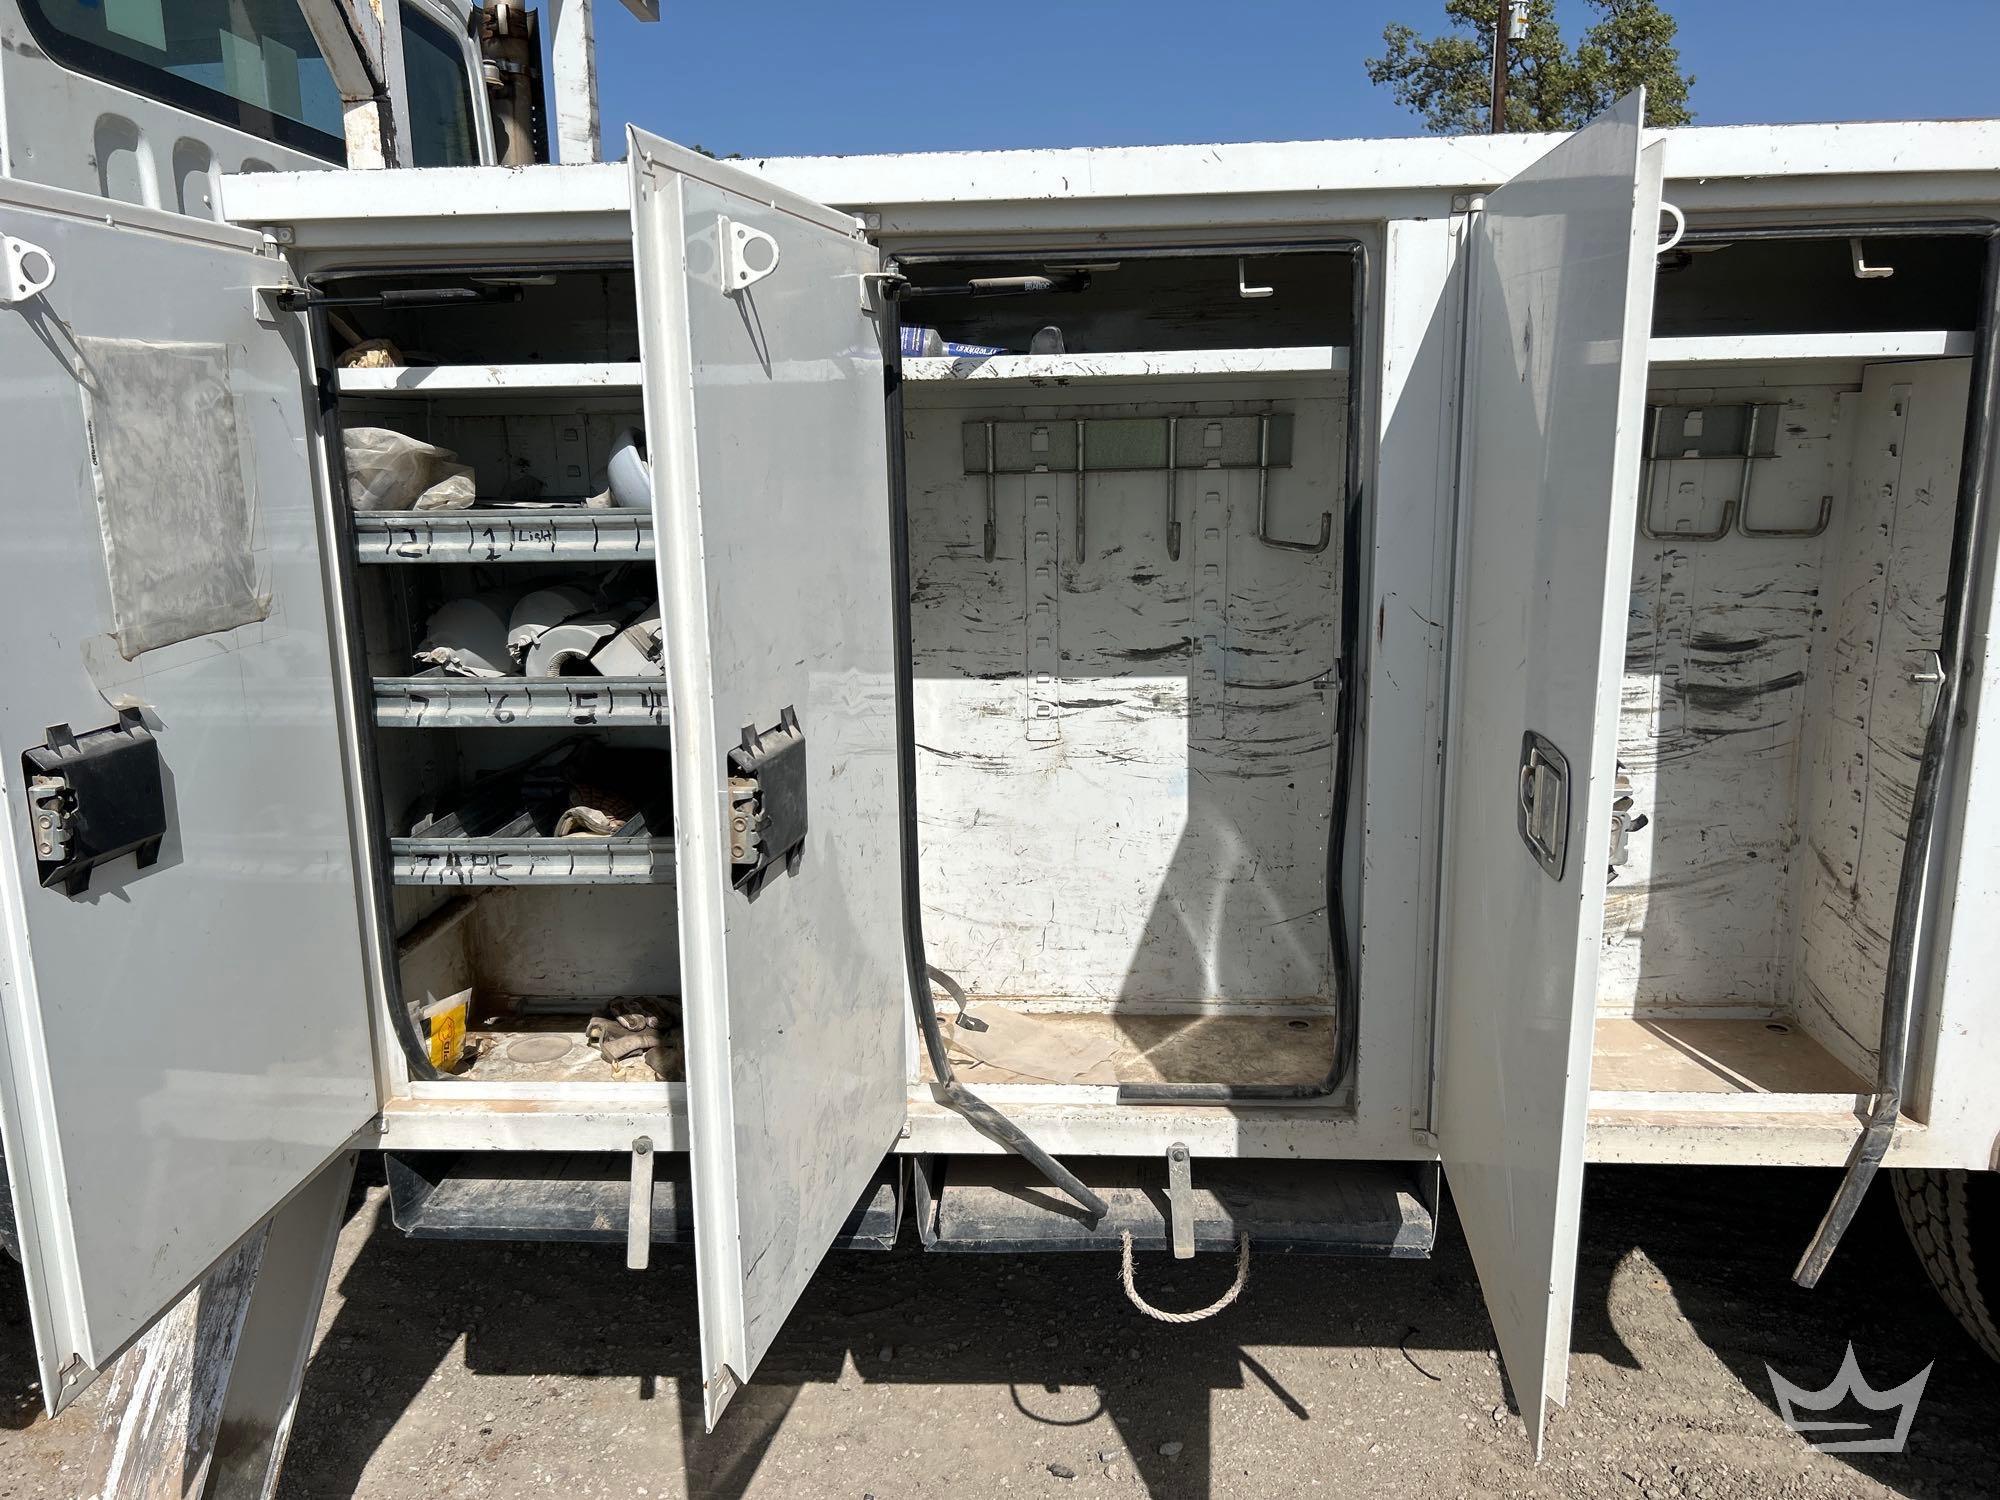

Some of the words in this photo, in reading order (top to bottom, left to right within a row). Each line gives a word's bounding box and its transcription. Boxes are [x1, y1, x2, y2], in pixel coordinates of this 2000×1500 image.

[396, 527, 423, 559] 2
[482, 527, 502, 561] 1
[518, 529, 552, 544] Light
[409, 693, 430, 727] 7
[493, 693, 516, 725] 6
[573, 691, 599, 725] 5
[415, 852, 513, 884] TAPE
